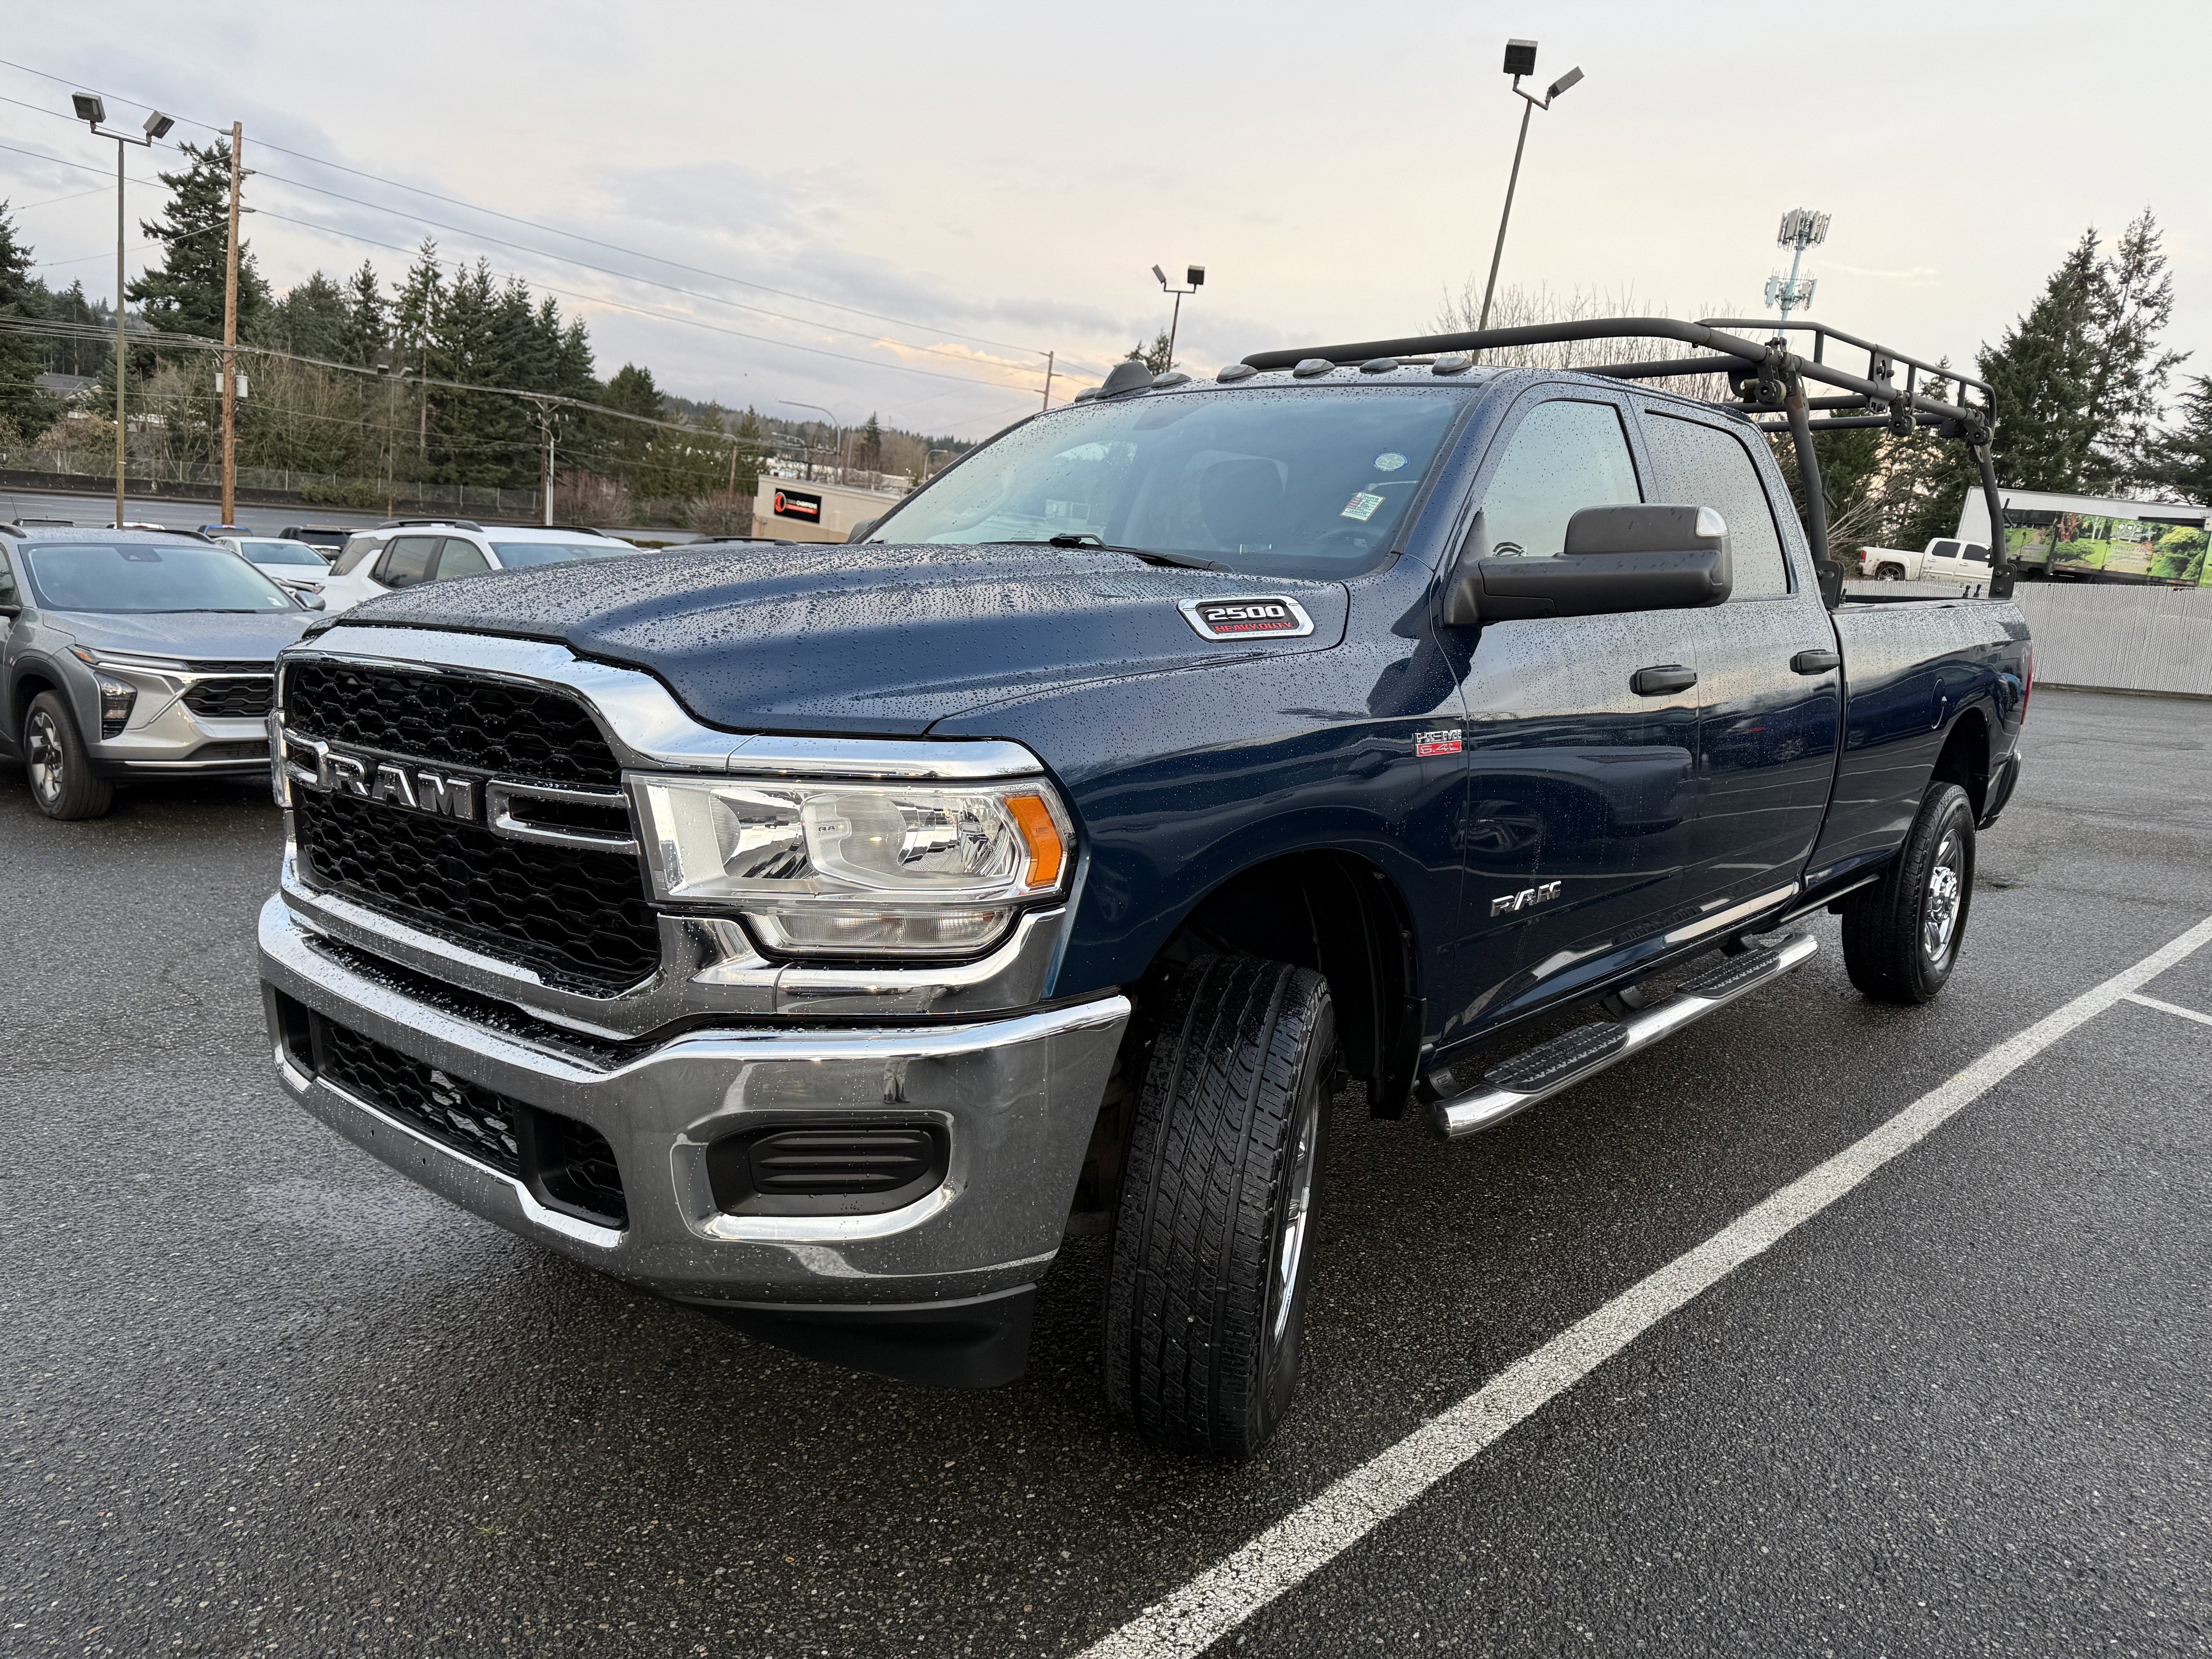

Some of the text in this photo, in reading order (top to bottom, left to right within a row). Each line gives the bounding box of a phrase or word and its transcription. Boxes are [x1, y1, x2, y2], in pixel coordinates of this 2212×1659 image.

[1204, 605, 1285, 620] 2500
[1214, 622, 1291, 632] HEAVY DUTY
[1416, 729, 1462, 744] HEMI
[1420, 744, 1460, 754] 6.4L
[321, 752, 474, 821] RAM
[1490, 880, 1562, 917] RAM
